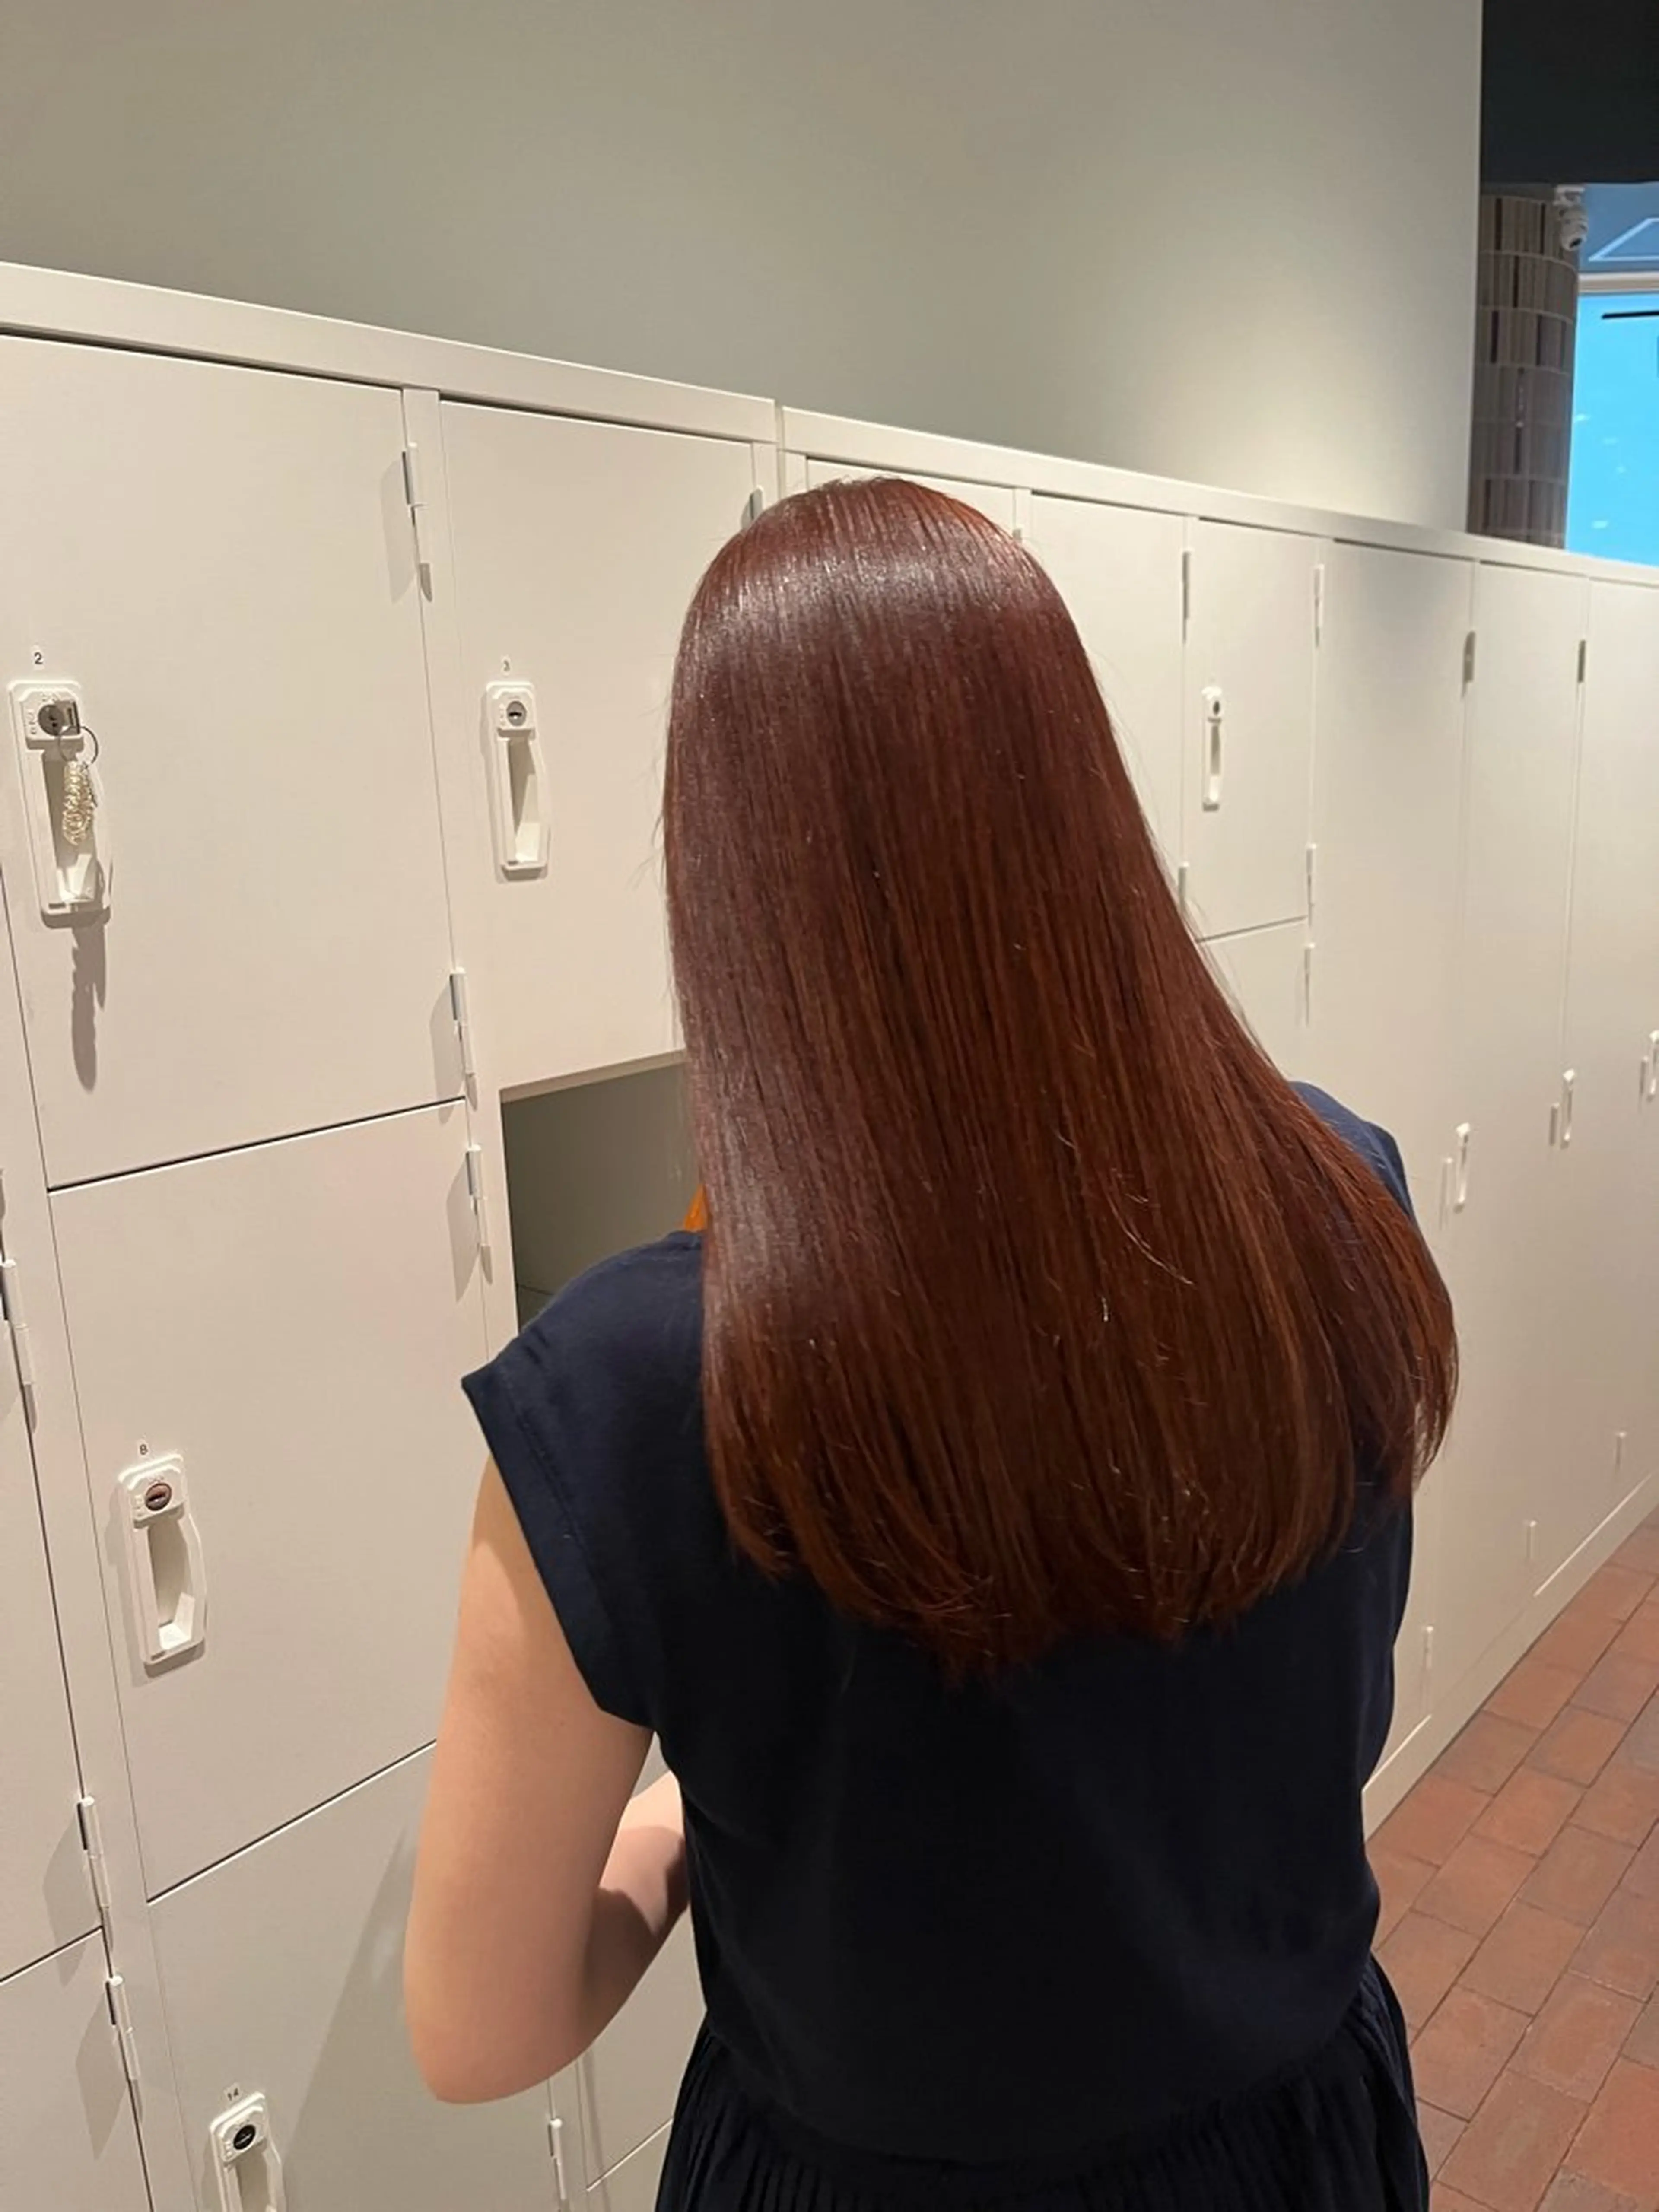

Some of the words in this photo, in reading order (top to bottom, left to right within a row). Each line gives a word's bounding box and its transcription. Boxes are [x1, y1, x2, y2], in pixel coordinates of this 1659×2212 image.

[34, 652, 43, 665] 2
[140, 1443, 149, 1455] 8
[227, 2087, 239, 2101] 14
